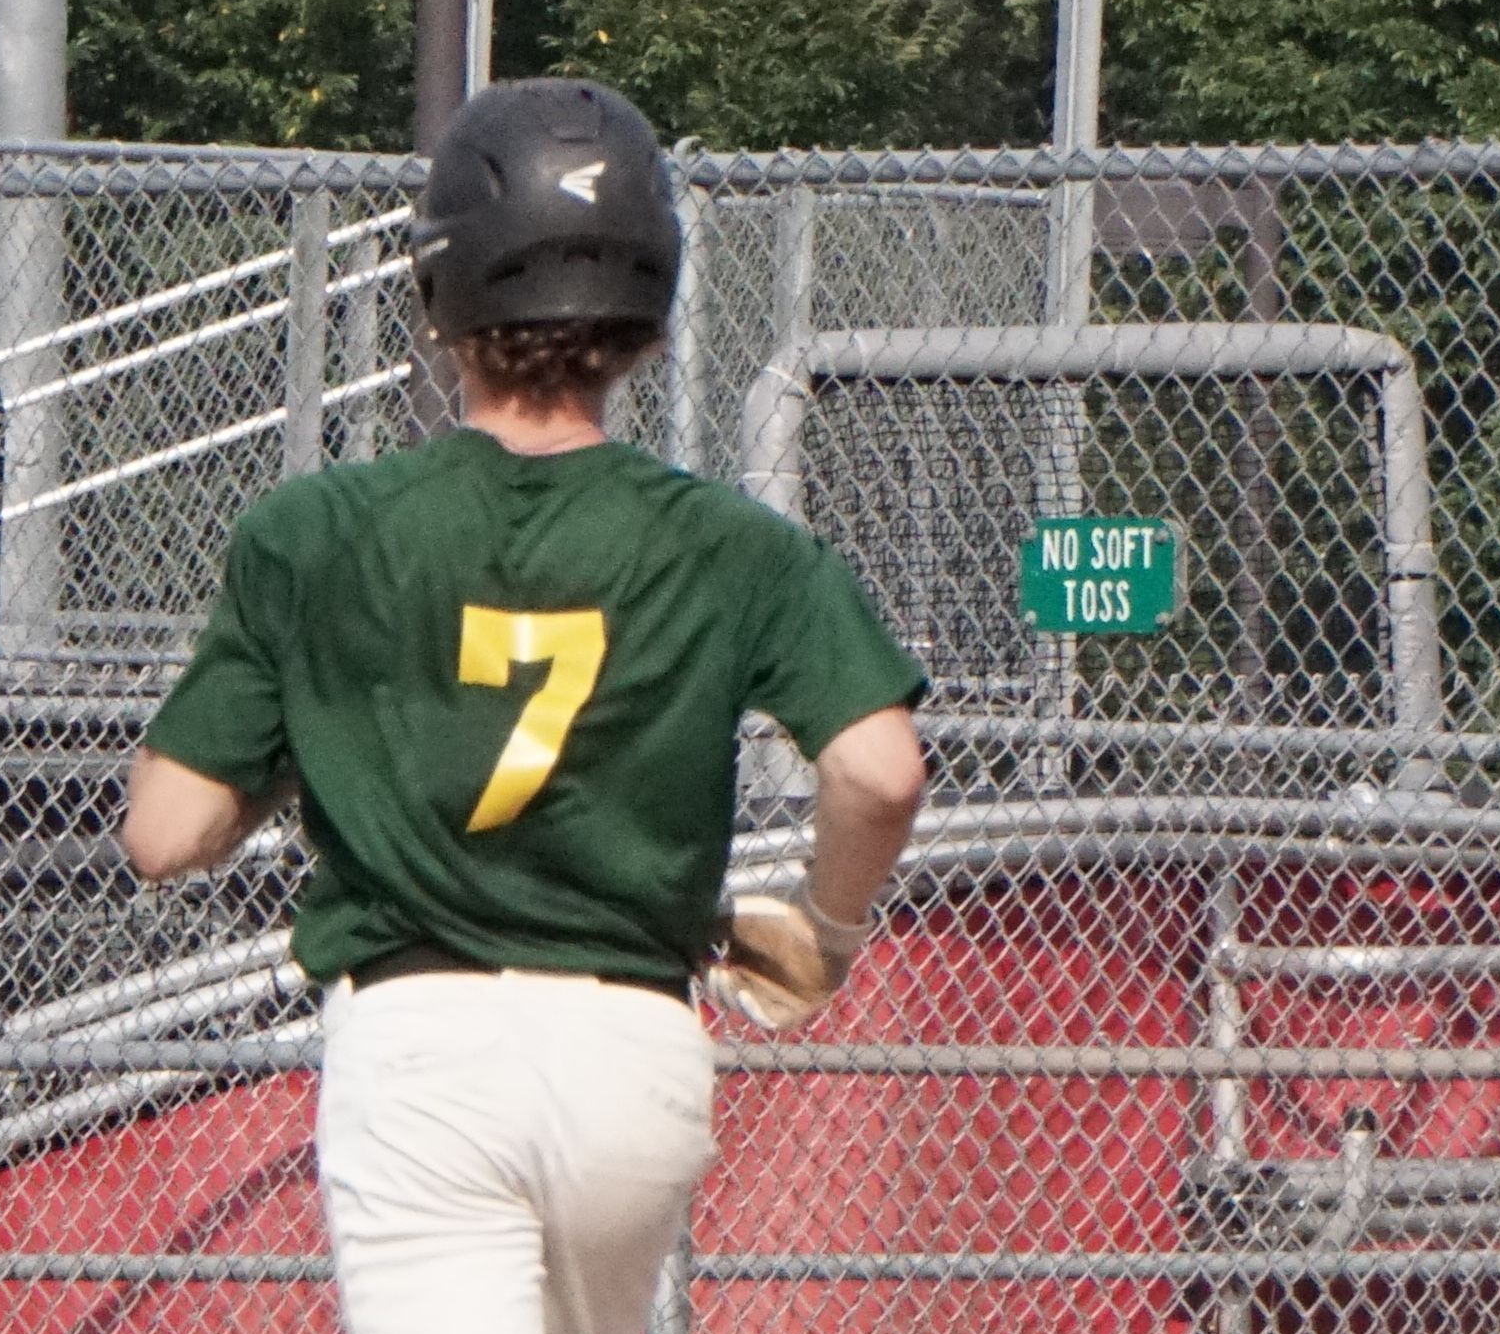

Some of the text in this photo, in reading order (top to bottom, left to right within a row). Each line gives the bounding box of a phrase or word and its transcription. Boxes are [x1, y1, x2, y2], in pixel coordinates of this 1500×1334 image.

[1042, 526, 1154, 570] NO SOFT
[1063, 580, 1130, 622] TOSS
[458, 603, 607, 834] 7
